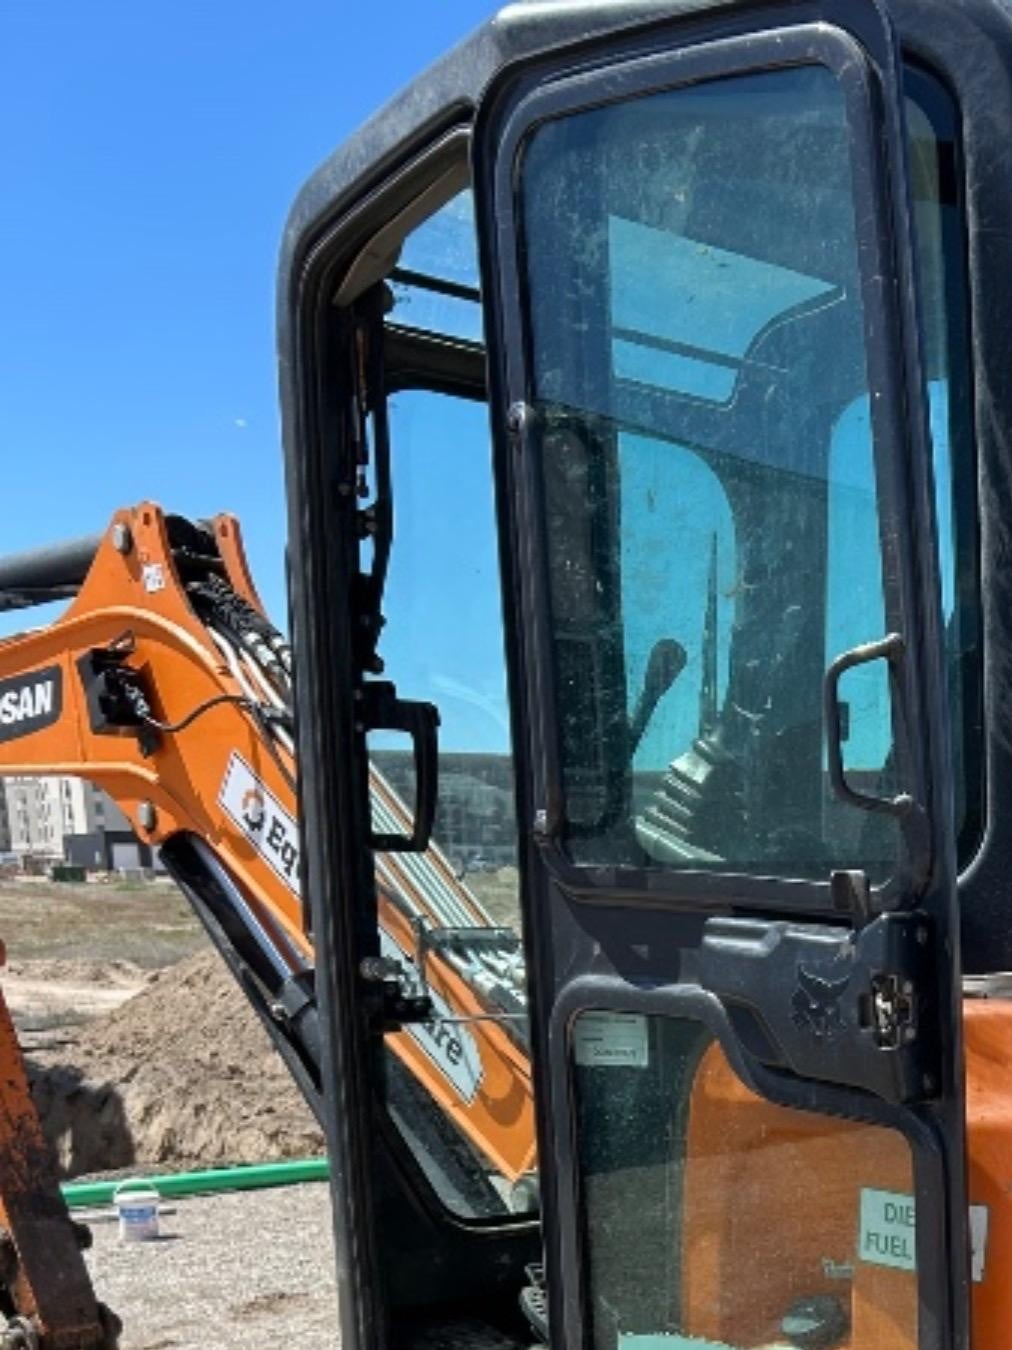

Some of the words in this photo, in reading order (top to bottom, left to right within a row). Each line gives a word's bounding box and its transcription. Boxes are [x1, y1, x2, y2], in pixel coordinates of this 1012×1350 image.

[0, 680, 53, 724] SAN
[266, 815, 301, 878] Eq
[884, 1202, 916, 1227] DIE
[865, 1231, 912, 1260] FUEL
